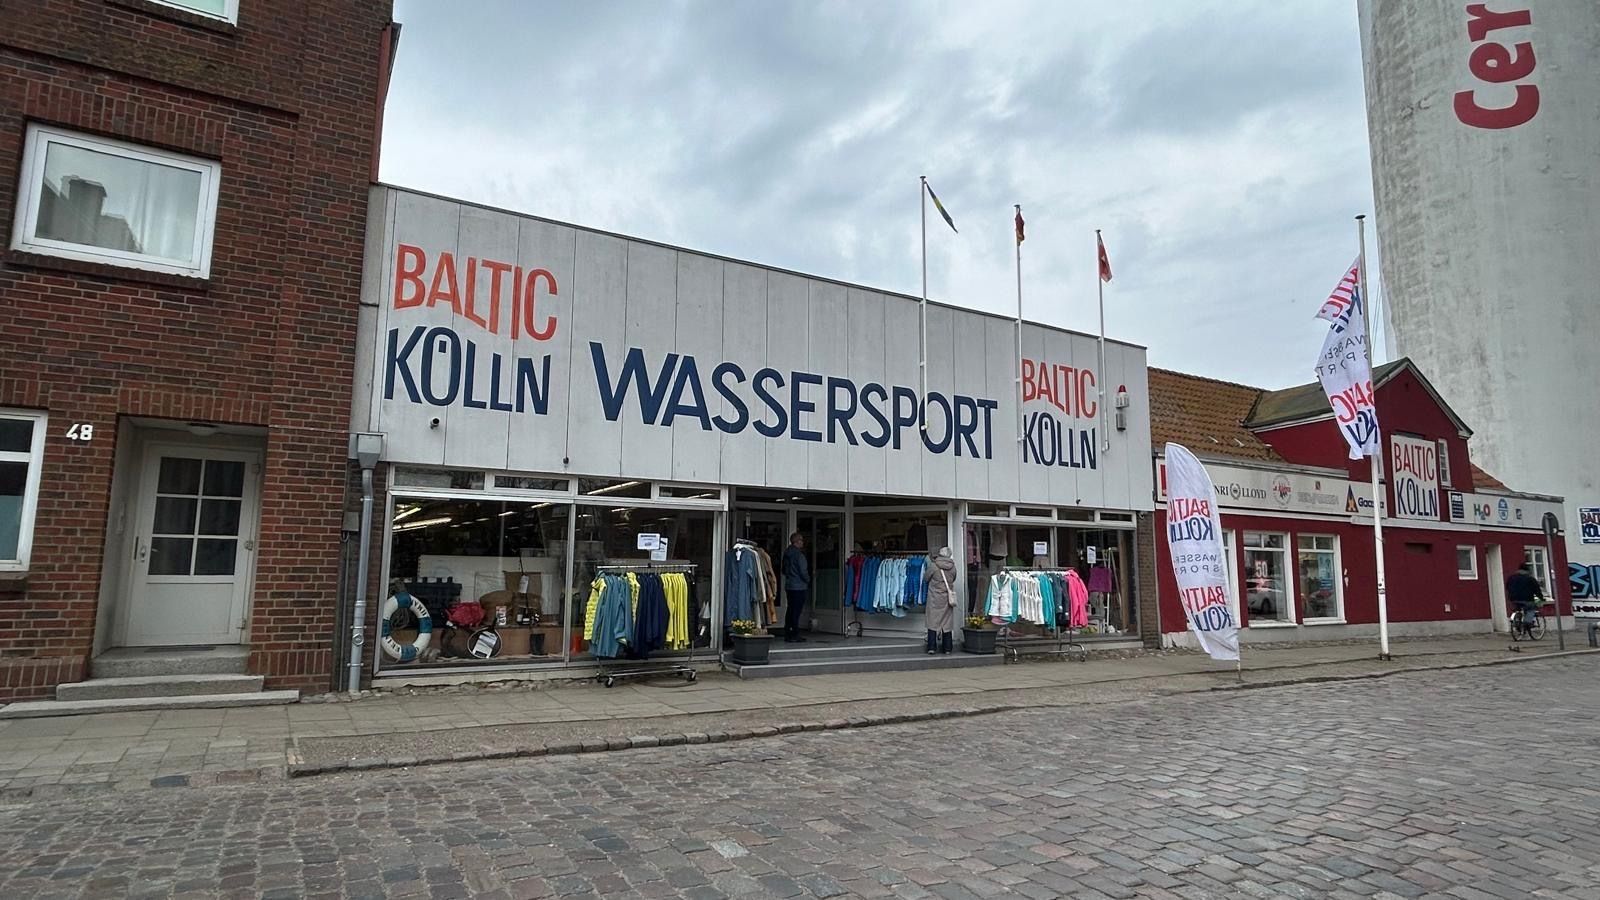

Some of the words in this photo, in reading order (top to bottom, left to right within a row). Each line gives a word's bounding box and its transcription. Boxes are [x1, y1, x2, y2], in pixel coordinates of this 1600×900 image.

[1453, 4, 1540, 129] Cer
[394, 243, 558, 341] BALTIC
[589, 341, 998, 460] WASSERSPORT
[1021, 358, 1097, 419] BALTIC
[66, 423, 94, 441] 48
[1393, 442, 1435, 482] BALTIC
[1242, 487, 1267, 500] LLOYD
